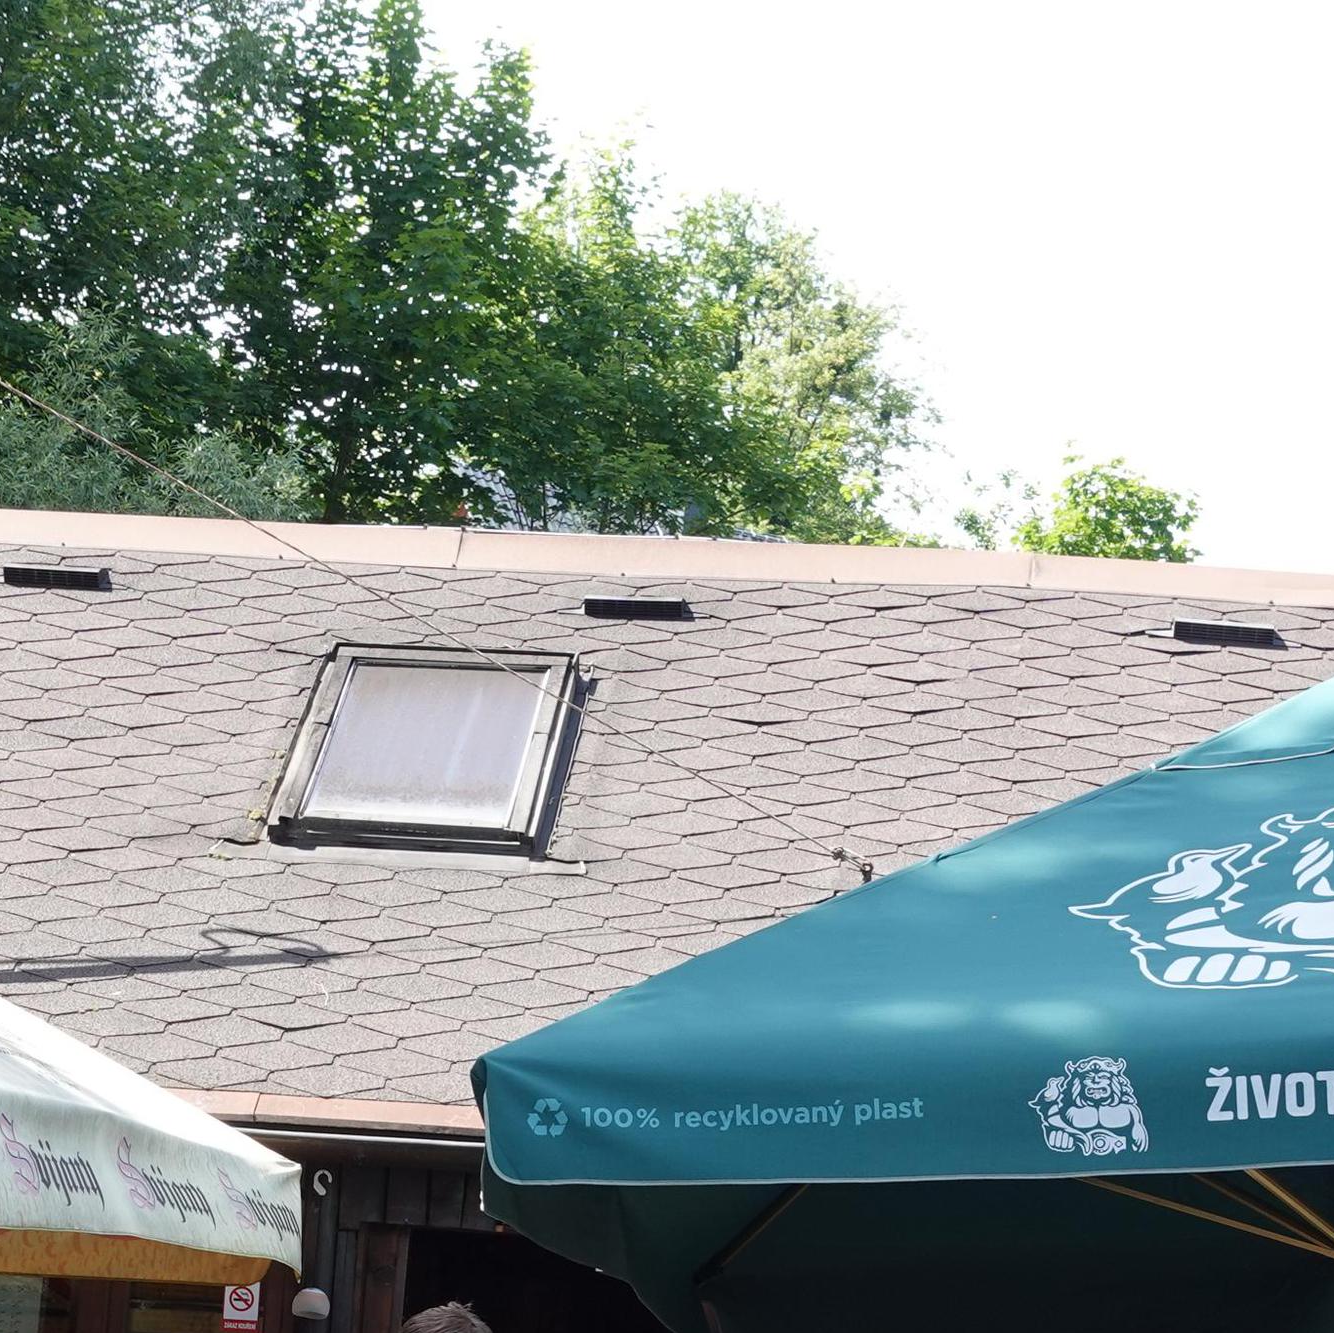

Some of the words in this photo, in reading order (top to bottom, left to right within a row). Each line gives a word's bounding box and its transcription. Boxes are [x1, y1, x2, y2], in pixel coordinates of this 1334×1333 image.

[580, 1106, 660, 1130] 100%
[674, 1099, 845, 1131] recyklovaný
[854, 1097, 925, 1126] plast
